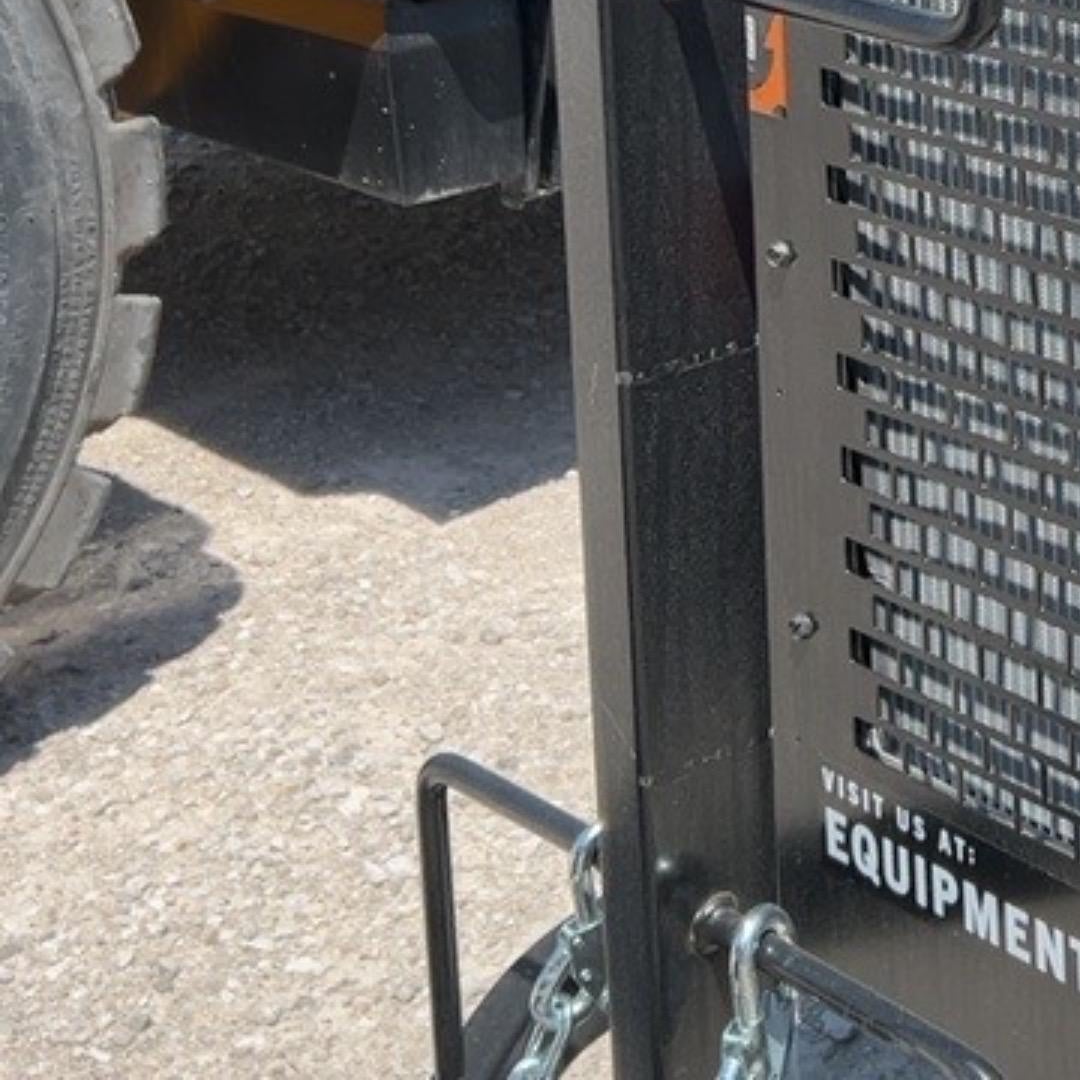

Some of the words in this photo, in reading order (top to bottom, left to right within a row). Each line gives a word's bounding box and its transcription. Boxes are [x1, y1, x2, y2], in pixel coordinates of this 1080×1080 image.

[821, 765, 884, 819] VISIT
[896, 805, 927, 841] US
[938, 827, 976, 865] AT:
